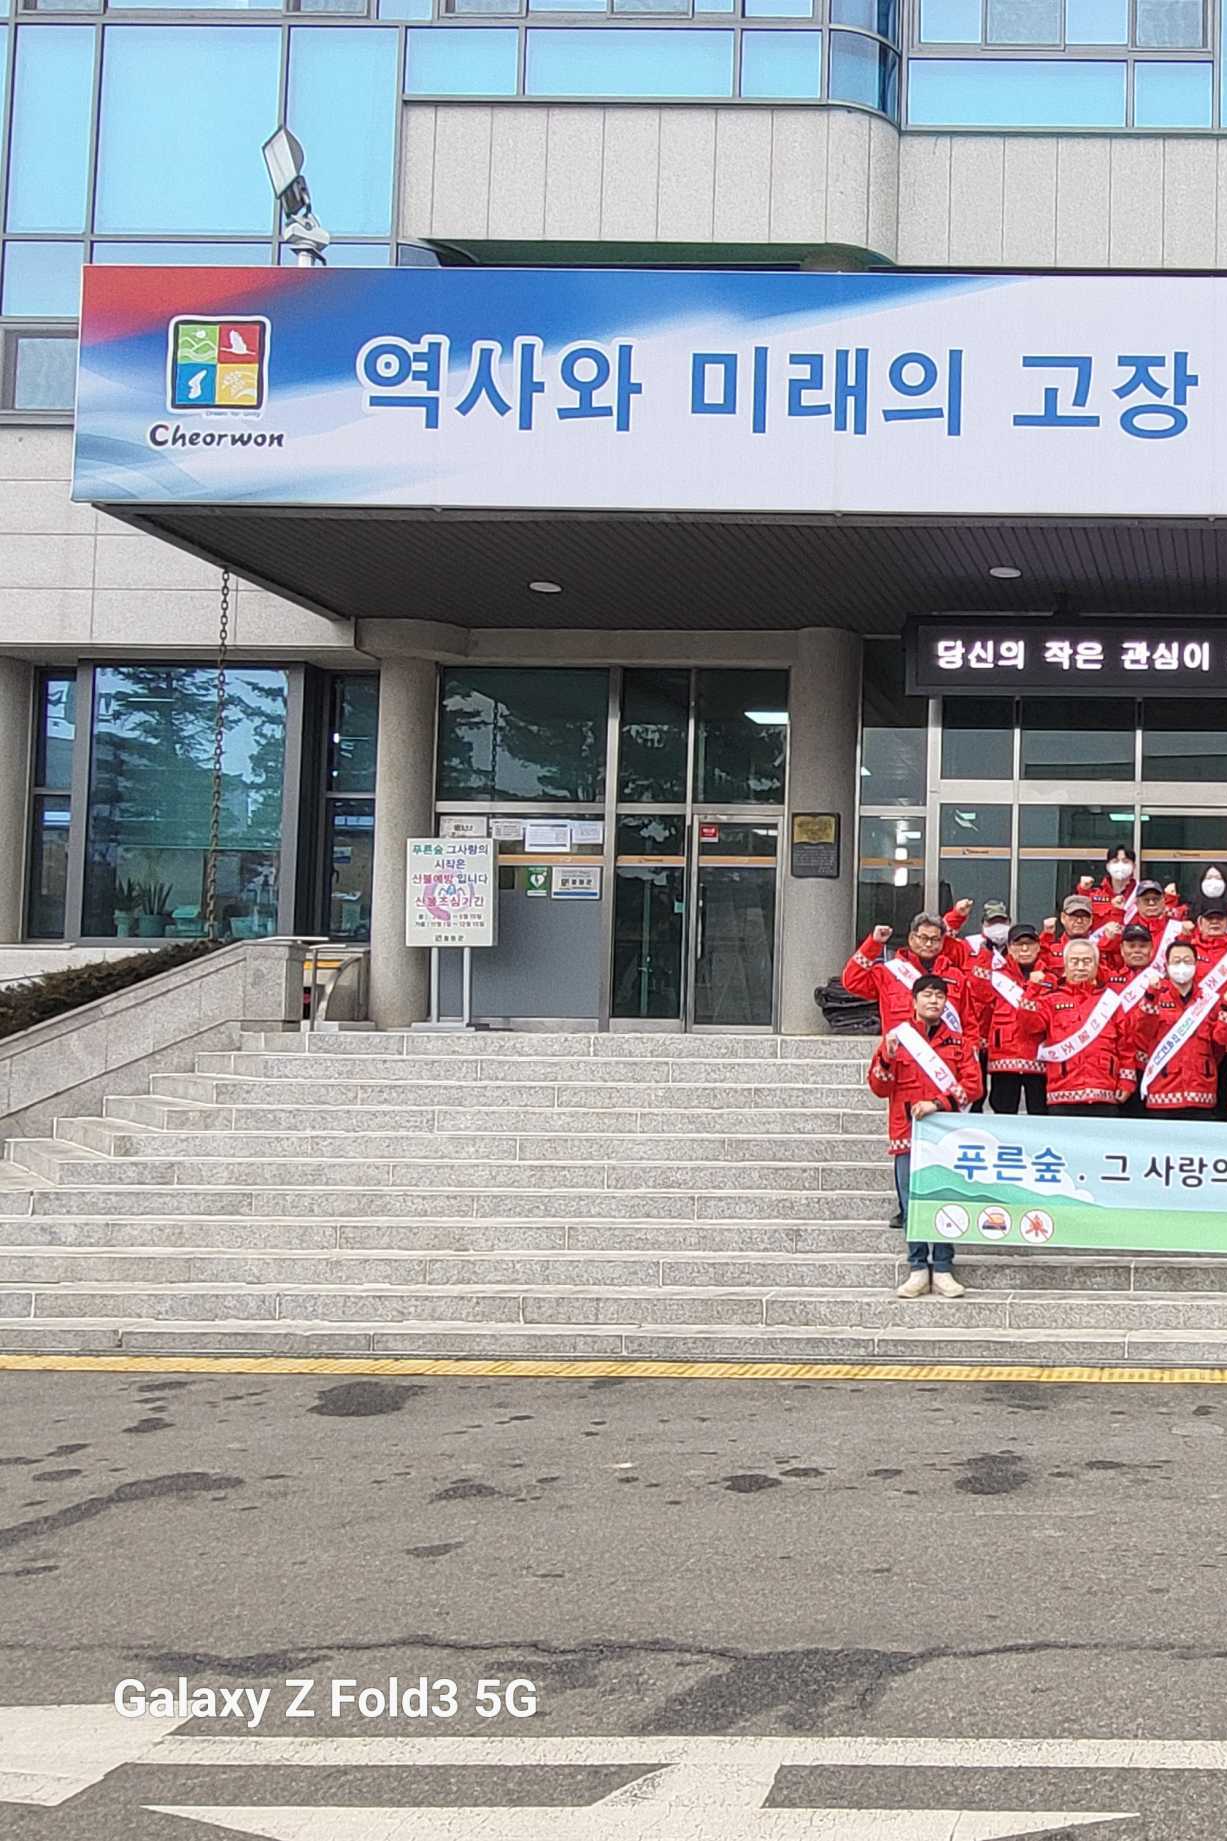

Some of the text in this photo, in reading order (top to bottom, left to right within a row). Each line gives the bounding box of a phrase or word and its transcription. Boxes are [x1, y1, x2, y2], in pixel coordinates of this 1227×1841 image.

[363, 340, 642, 432] 역사와
[691, 346, 963, 437] 미래의
[1012, 351, 1199, 439] 고장
[150, 424, 284, 447] Cheorwon
[937, 639, 1025, 670] 당신의
[1044, 640, 1104, 670] 작은
[1120, 641, 1210, 672] 관심이
[1101, 1155, 1131, 1182] 그
